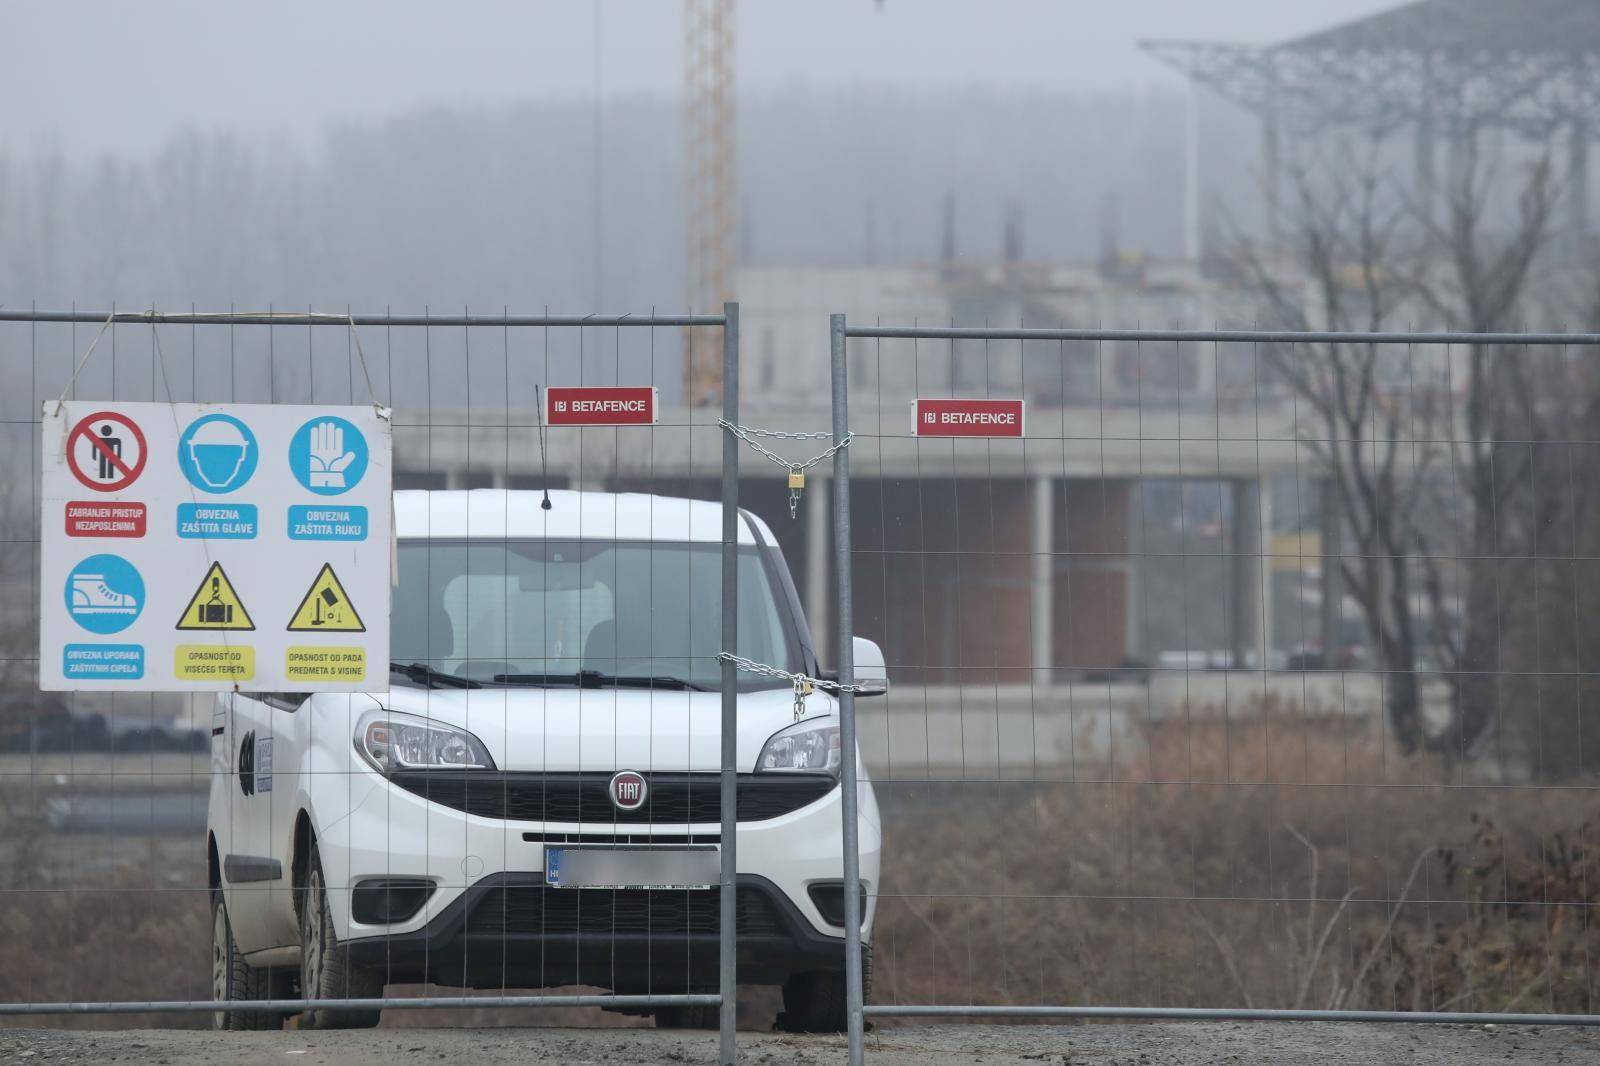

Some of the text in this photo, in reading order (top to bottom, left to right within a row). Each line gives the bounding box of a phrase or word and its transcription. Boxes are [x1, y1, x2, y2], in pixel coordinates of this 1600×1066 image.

[572, 400, 646, 412] BETAFENCE
[941, 412, 1015, 424] BETAFENCE
[112, 508, 143, 518] PRISTUP
[195, 509, 240, 520] OBVEZNA
[306, 511, 350, 522] OBVEZNA
[181, 520, 253, 534] ZAŠTITA GLAVE
[294, 522, 361, 536] ZAŠTITA RUKU
[188, 652, 241, 661] OPASNOST OD
[288, 653, 362, 662] OPASNOST OD PADA
[217, 665, 245, 674] TERETA
[288, 666, 363, 675] PREDMETA S VISINE
[618, 782, 640, 800] FIAT
